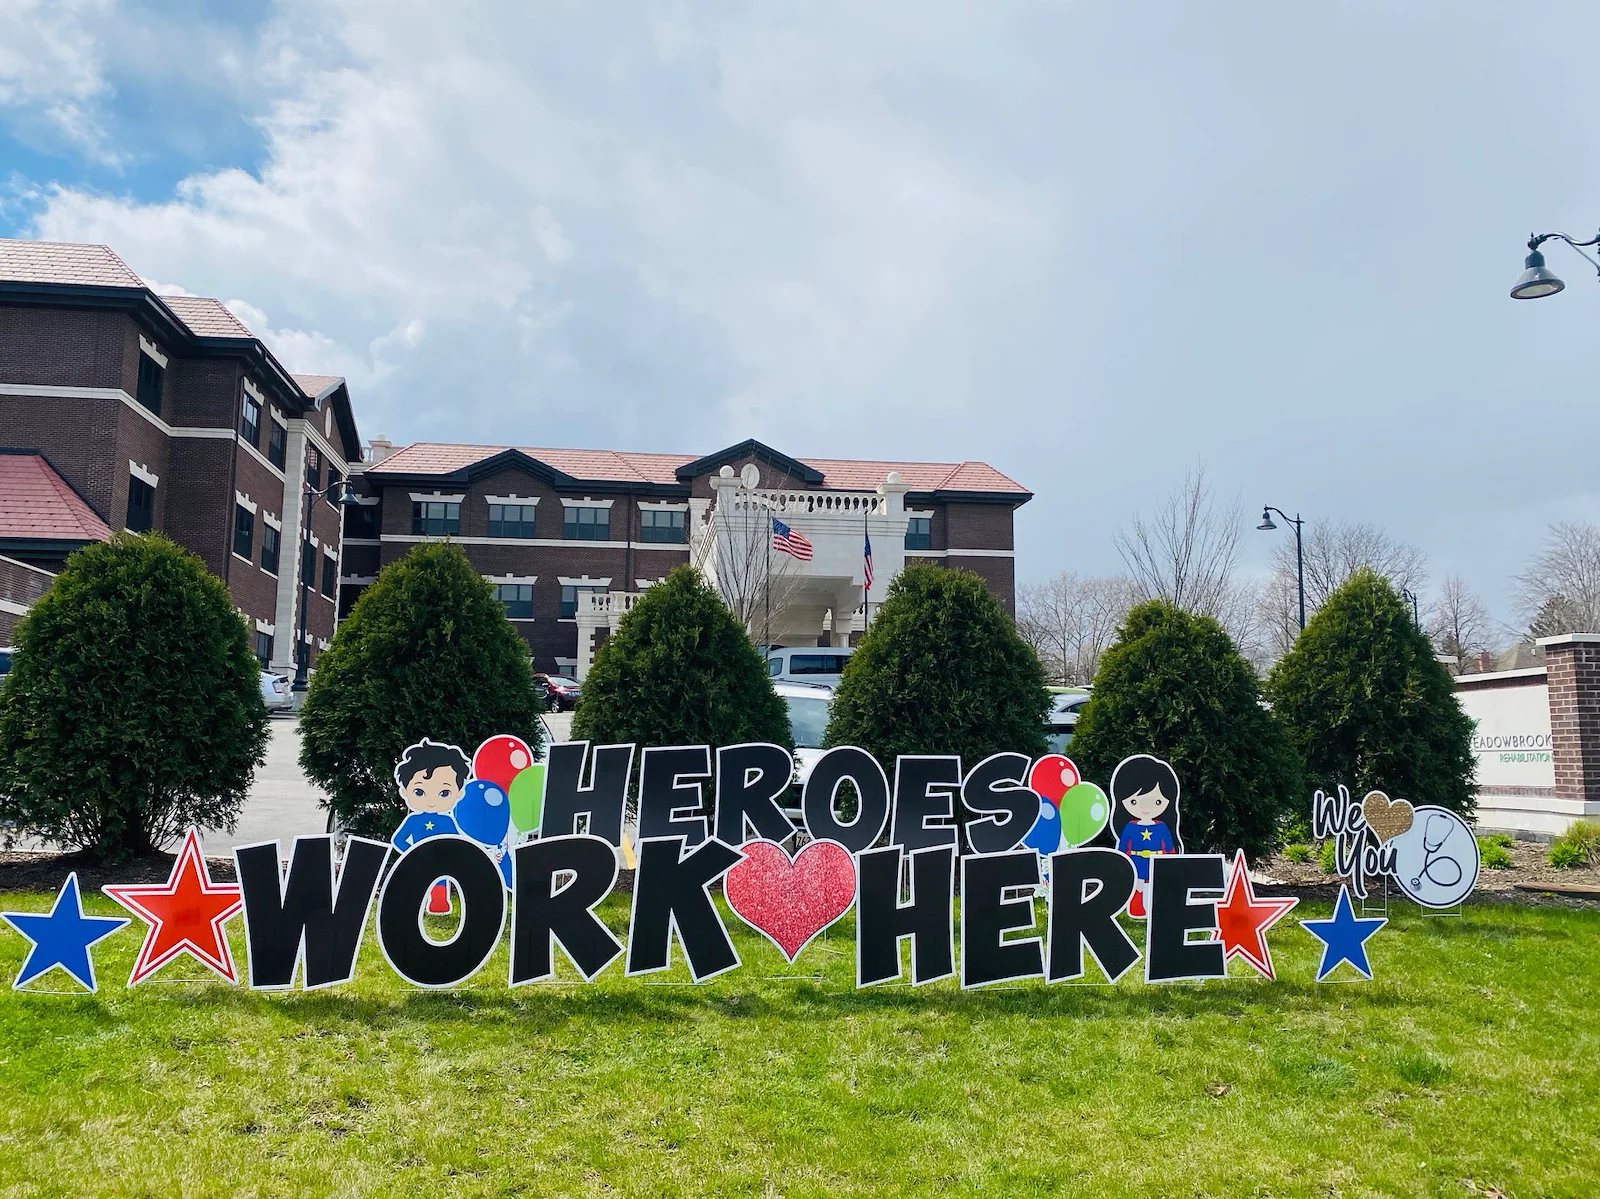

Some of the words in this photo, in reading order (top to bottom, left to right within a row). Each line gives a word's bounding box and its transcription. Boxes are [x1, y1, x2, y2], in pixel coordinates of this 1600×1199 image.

[1473, 733, 1552, 749] EADOWBROOK
[1499, 752, 1551, 763] REHABILITATION
[539, 741, 1042, 854] HEROES
[1314, 785, 1366, 838] We
[1337, 830, 1398, 898] You
[233, 834, 749, 990] WORK
[856, 843, 1228, 989] HERE
